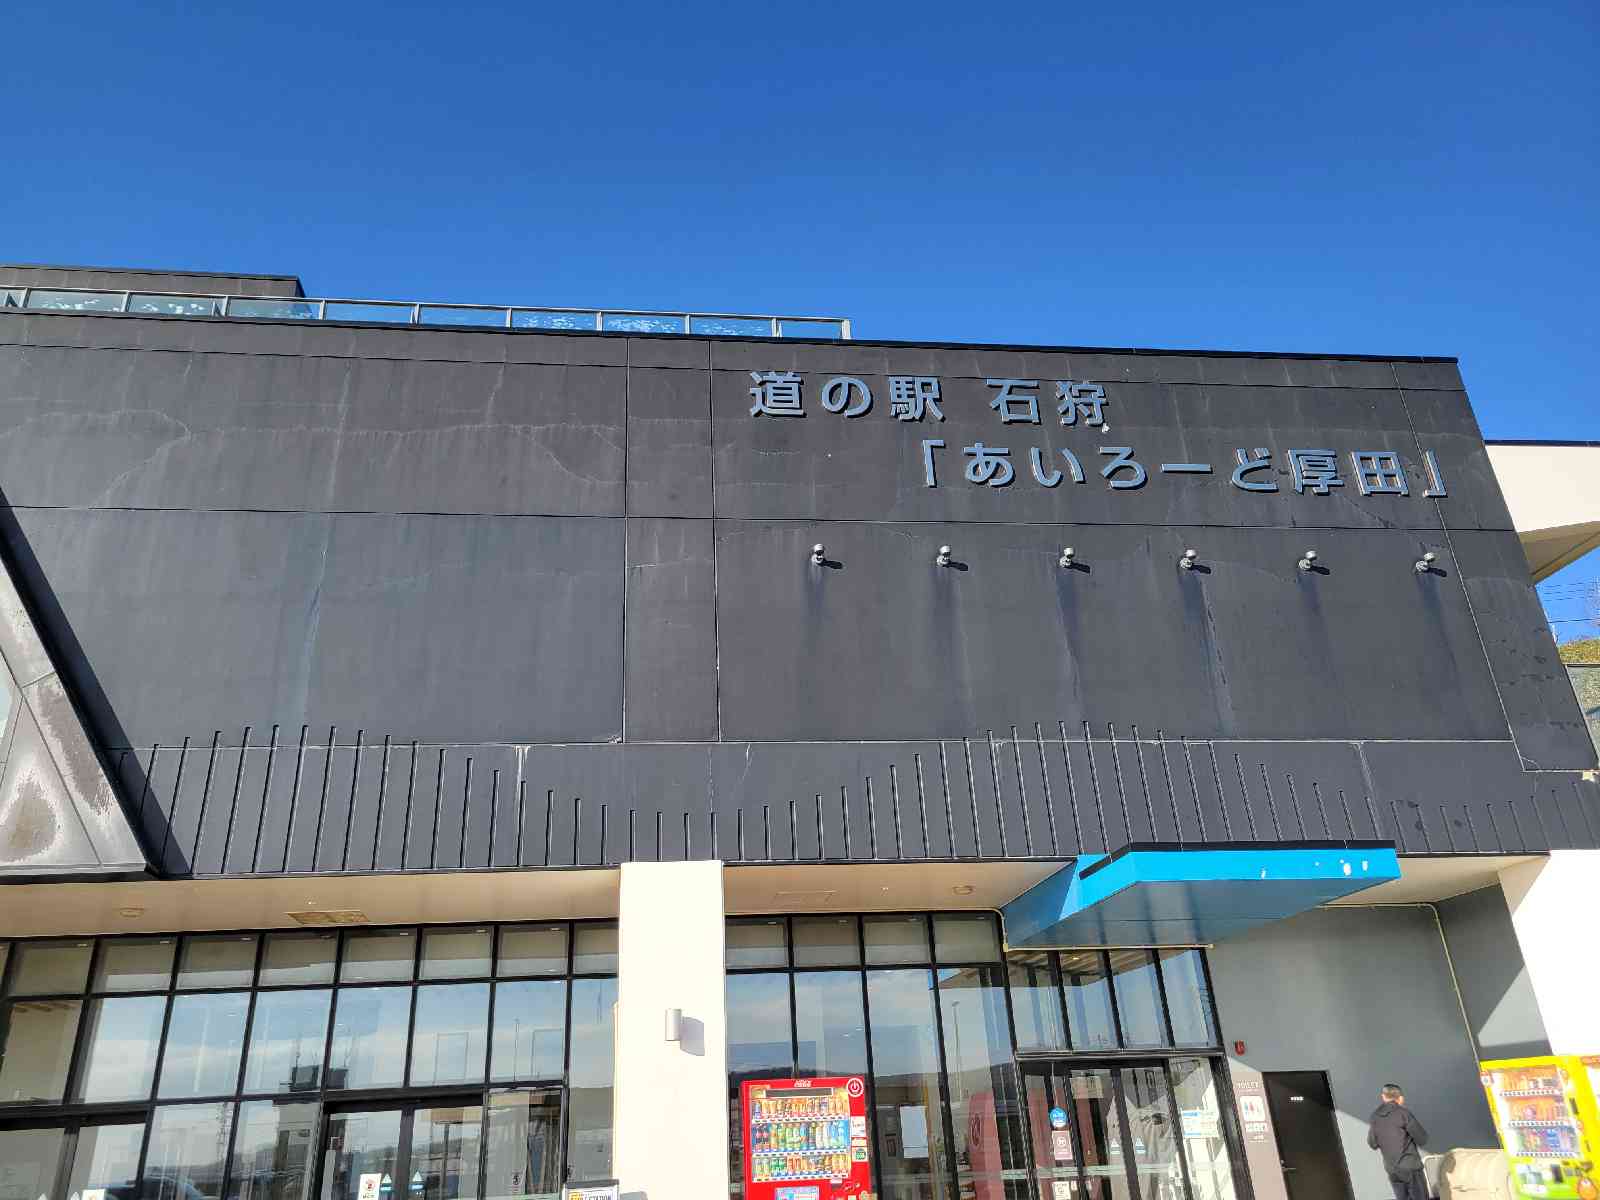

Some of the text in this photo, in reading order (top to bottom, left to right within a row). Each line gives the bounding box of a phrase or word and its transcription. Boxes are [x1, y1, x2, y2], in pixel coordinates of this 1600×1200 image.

[750, 371, 1108, 426] 道の駅 石狩
[922, 438, 1447, 498] 「あいろーど厚田」
